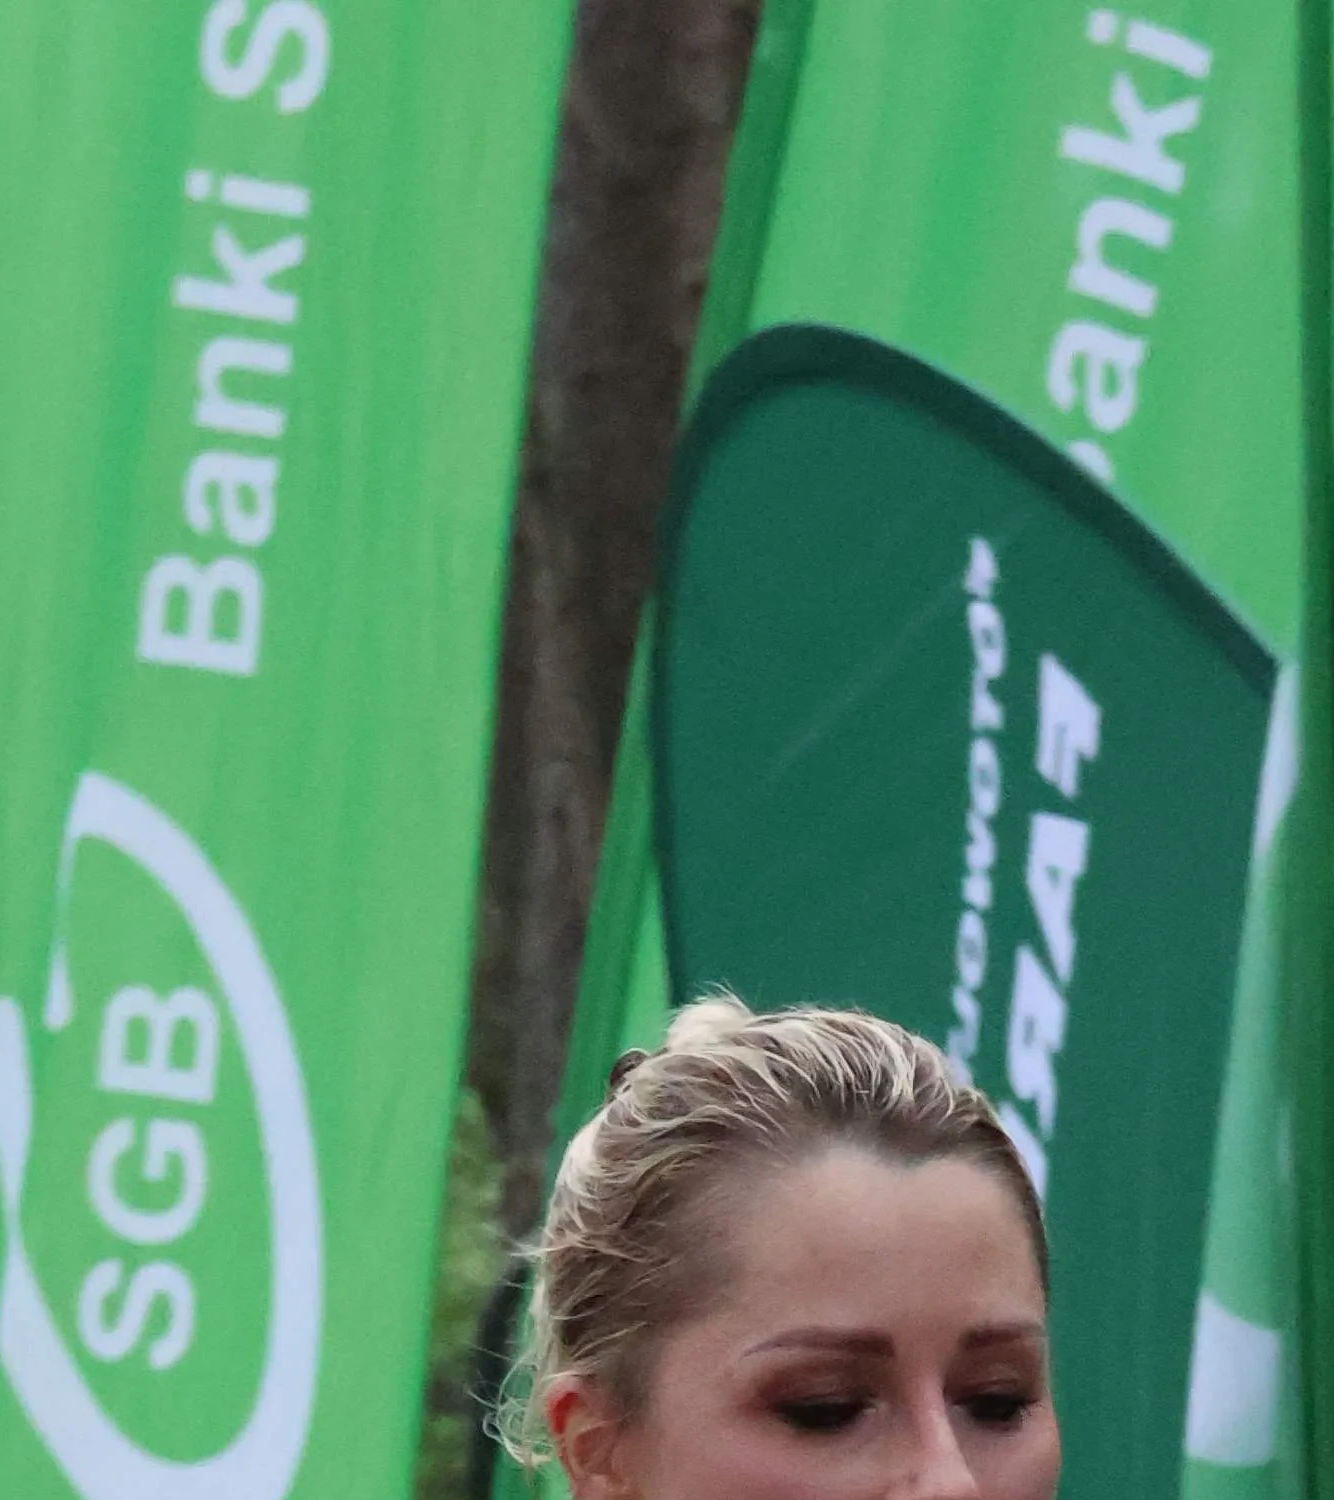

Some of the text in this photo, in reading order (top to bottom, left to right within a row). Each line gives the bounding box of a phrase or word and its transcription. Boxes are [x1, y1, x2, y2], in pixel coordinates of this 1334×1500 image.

[135, 168, 312, 678] Banki
[1046, 10, 1213, 483] anki
[77, 984, 221, 1372] SGB
